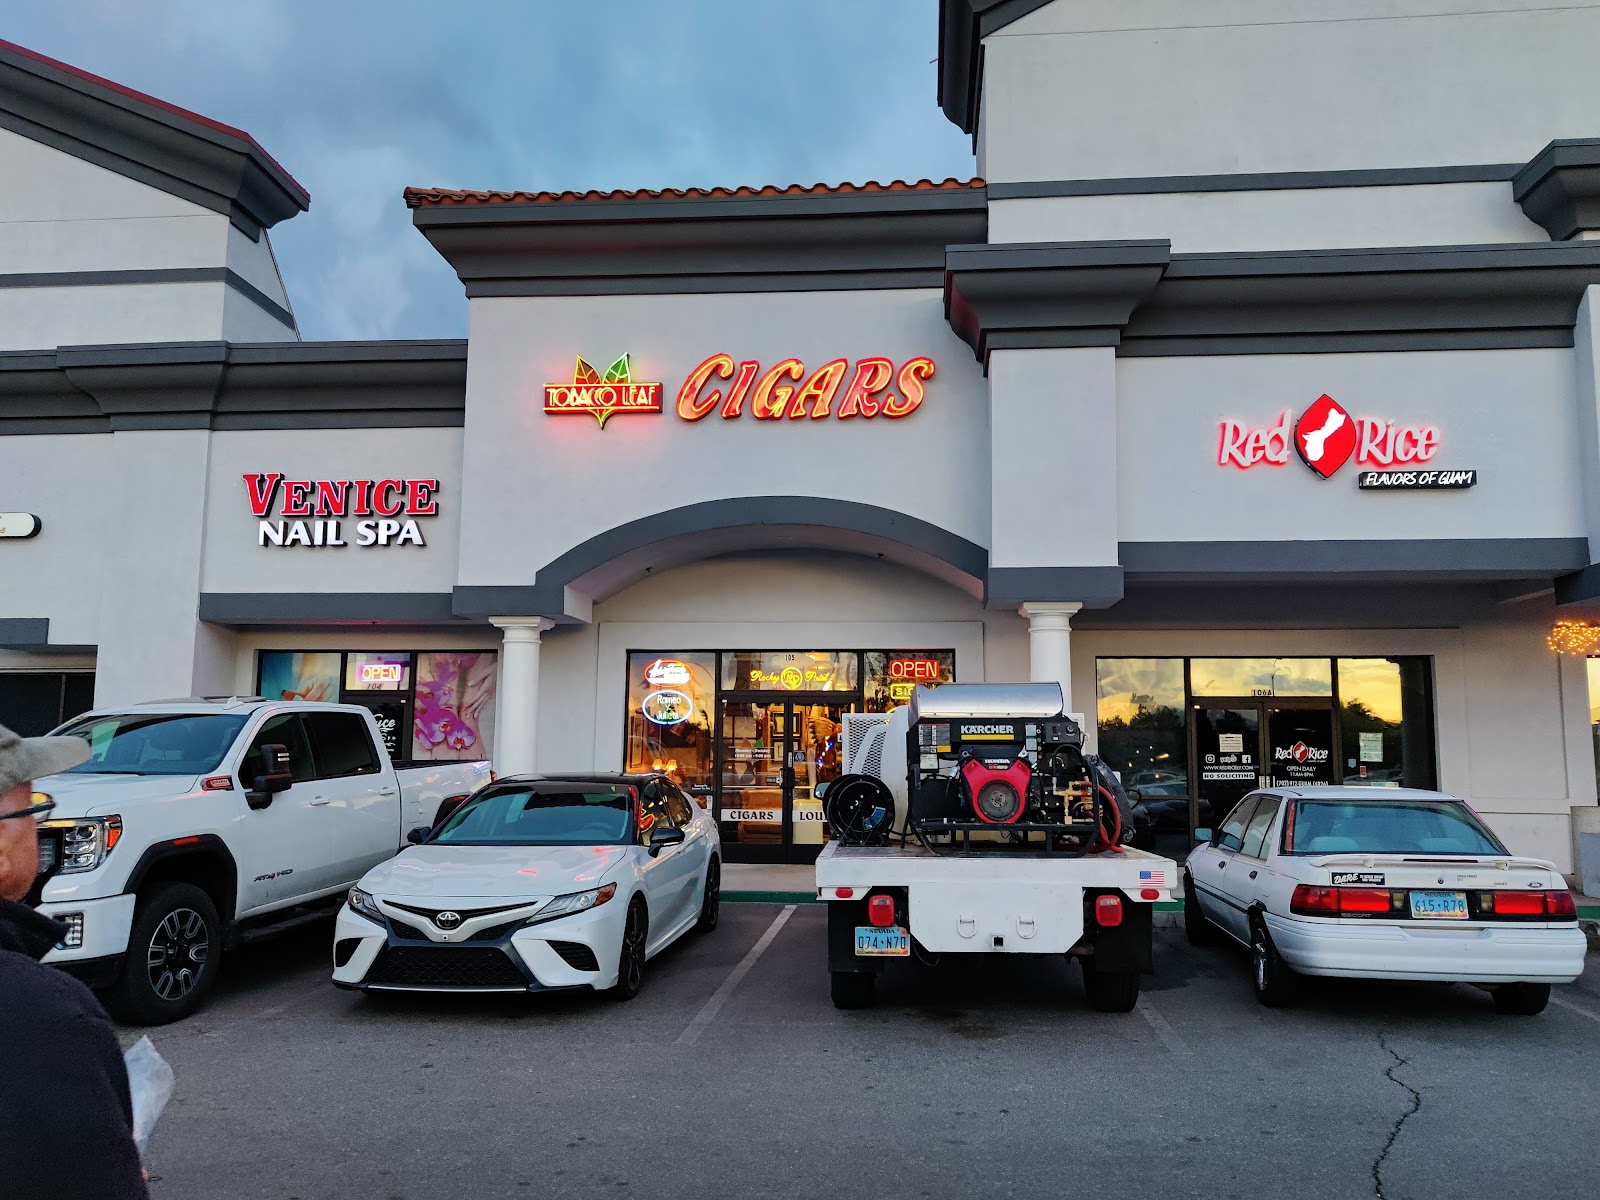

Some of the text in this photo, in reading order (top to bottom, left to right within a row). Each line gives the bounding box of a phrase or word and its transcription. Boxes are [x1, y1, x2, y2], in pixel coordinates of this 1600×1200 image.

[675, 352, 936, 421] CIGARS
[546, 386, 656, 407] TOBACCO LEAF
[1218, 408, 1441, 468] Red Rice
[1366, 471, 1473, 486] FLAVORS OF GUAM
[241, 472, 440, 518] VENICE
[258, 519, 427, 548] NAIL SPA
[362, 667, 398, 680] OPEN
[891, 661, 937, 677] OPEN
[750, 670, 779, 684] Rocky
[657, 694, 682, 704] Romeo
[1275, 745, 1328, 760] Red Rice
[730, 811, 774, 820] CIGARS
[1415, 900, 1464, 912] 615 R78
